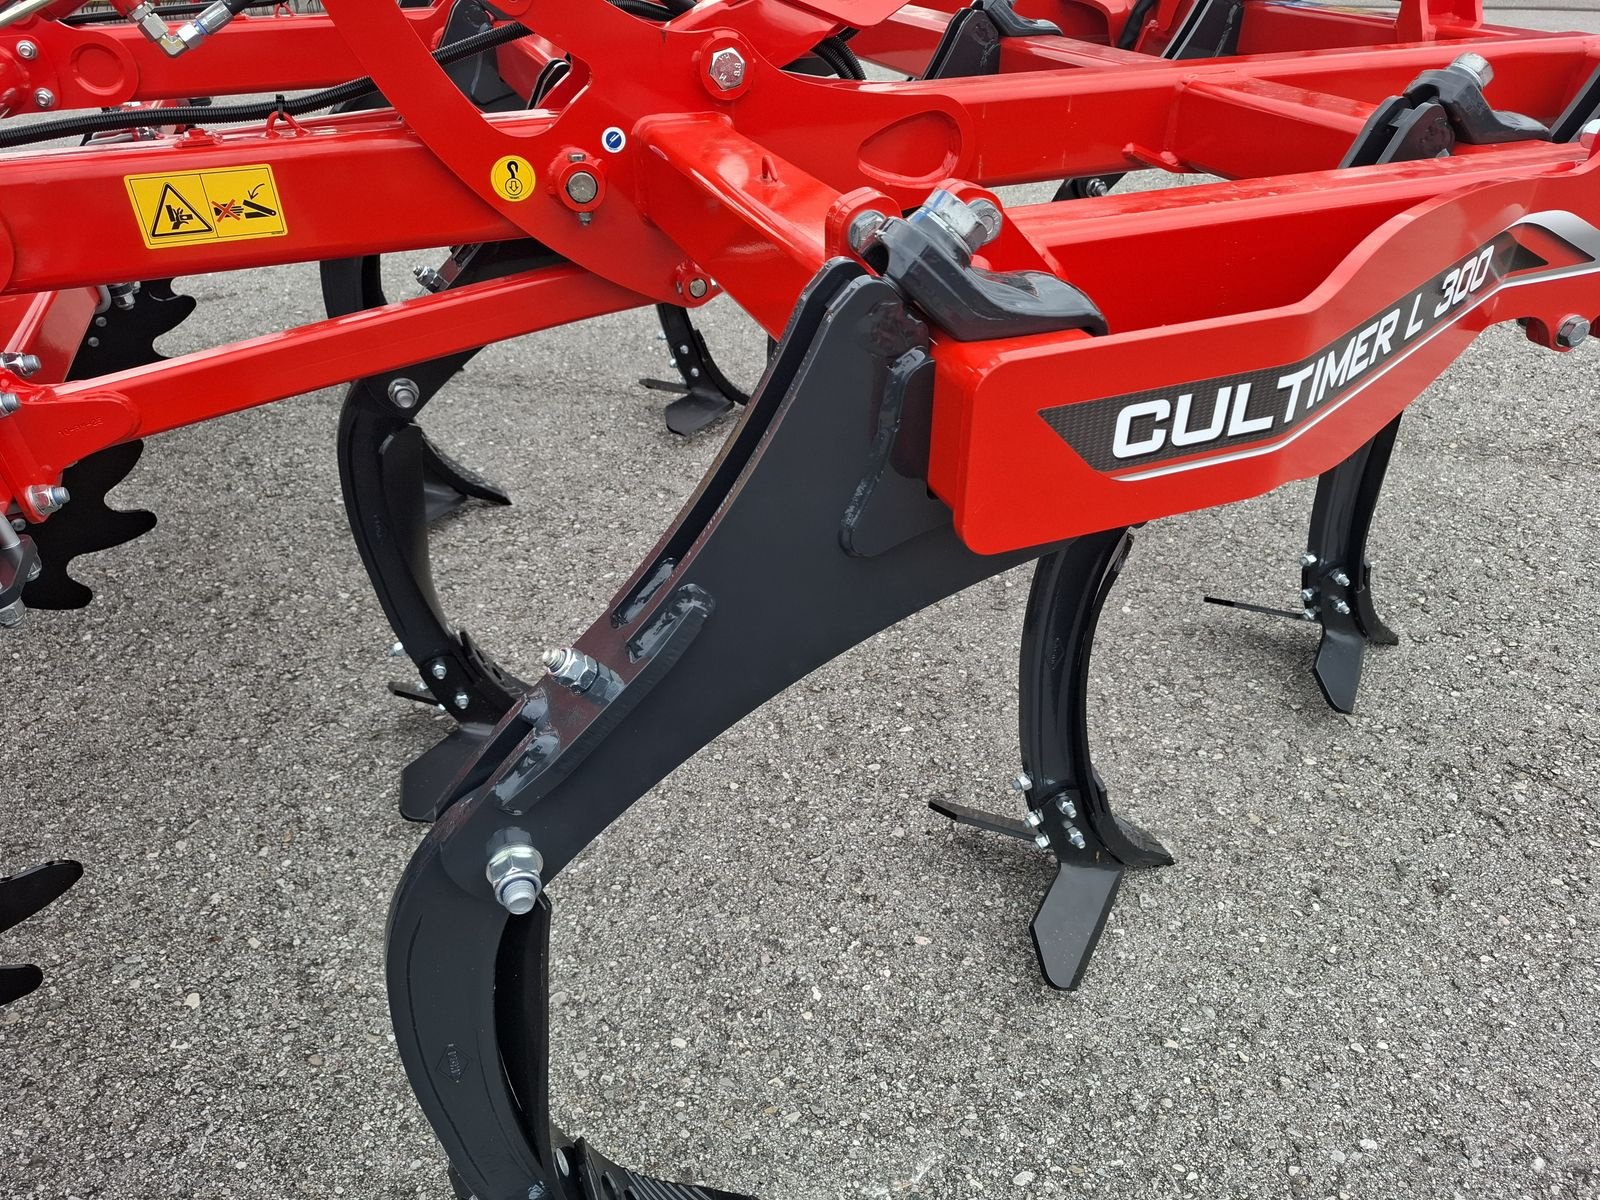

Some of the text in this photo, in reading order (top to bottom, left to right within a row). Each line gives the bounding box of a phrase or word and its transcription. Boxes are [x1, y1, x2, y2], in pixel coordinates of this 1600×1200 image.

[1112, 244, 1495, 459] CULTIMER L 300
